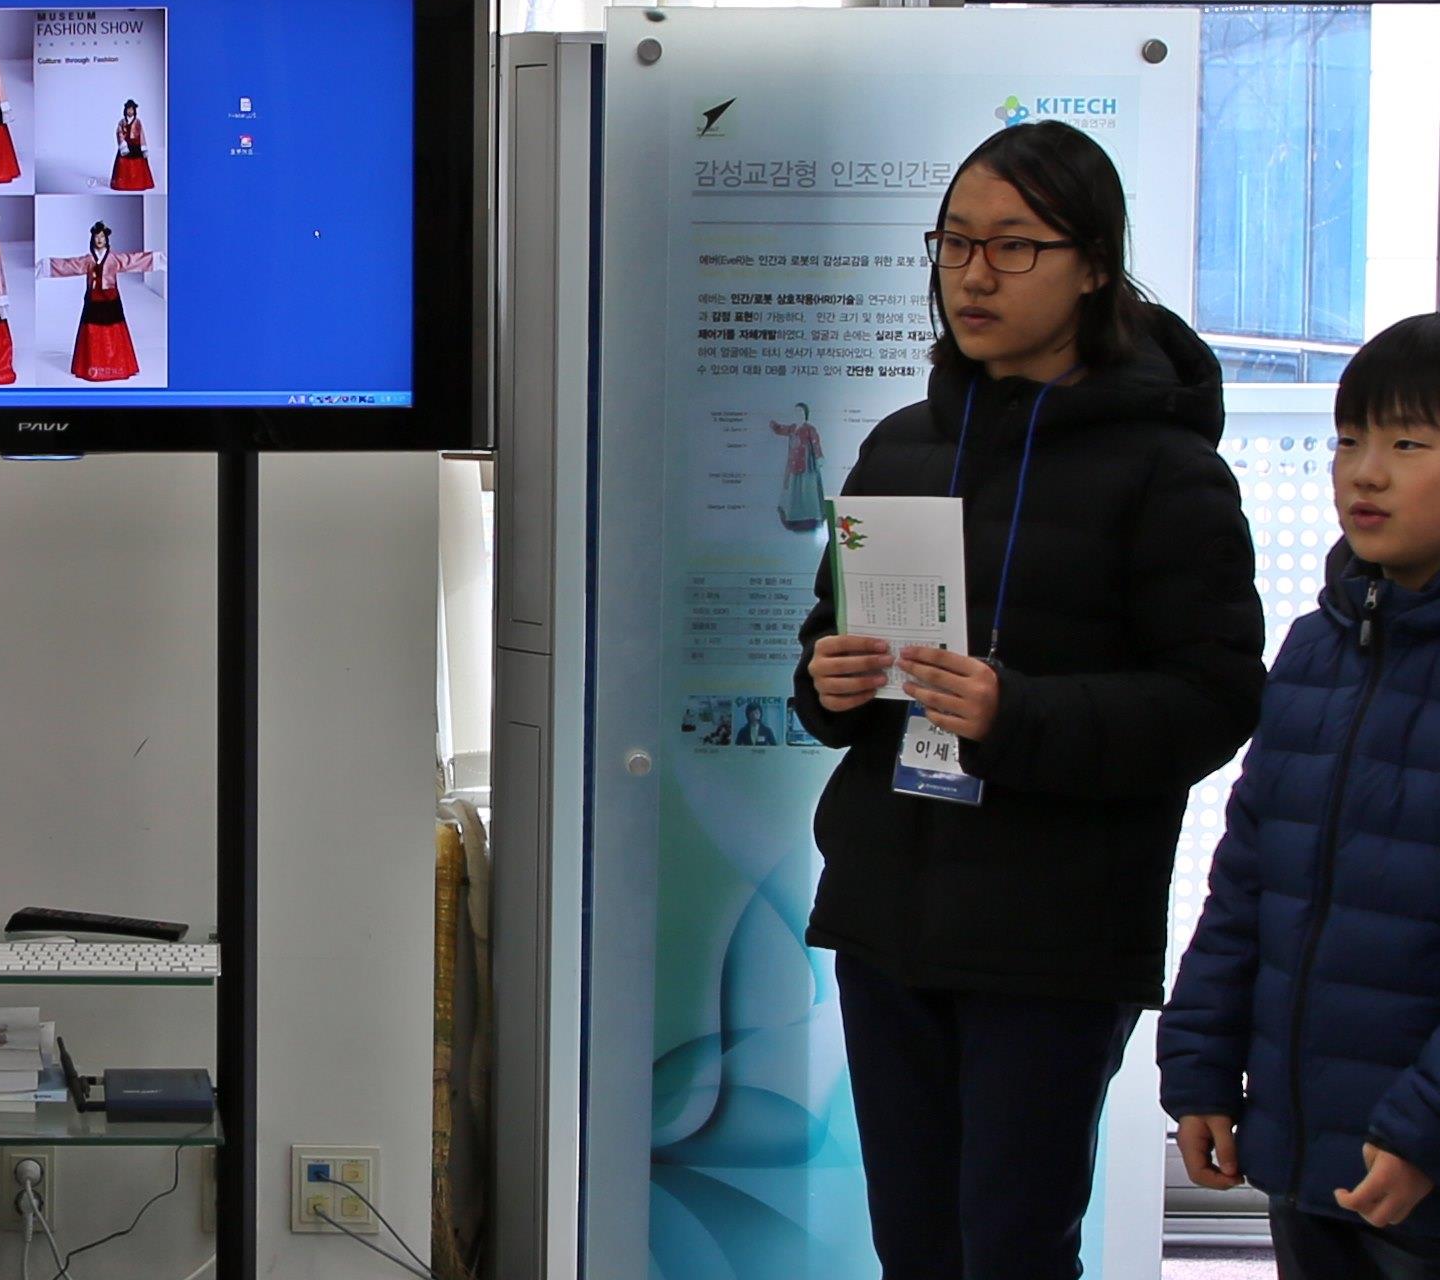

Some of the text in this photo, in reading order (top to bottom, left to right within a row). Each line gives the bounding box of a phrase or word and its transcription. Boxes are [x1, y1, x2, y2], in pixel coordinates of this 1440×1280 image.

[37, 11, 96, 21] MUSEUM
[37, 21, 144, 36] FASHION SHOW
[65, 56, 90, 65] through
[1036, 98, 1116, 114] KITECH
[694, 159, 960, 189] 감성교감형 인조인간로
[758, 255, 787, 267] 인간과
[791, 255, 819, 267] 로봇의
[823, 255, 869, 267] 감성교감을
[874, 255, 893, 267] 위한
[730, 294, 772, 305] 인간/로봇
[868, 294, 906, 305] 연구하기
[816, 311, 835, 323] 인간
[839, 311, 858, 323] 크기
[862, 311, 872, 323] 및
[876, 311, 904, 323] 형상에
[875, 329, 903, 341] 실리콘
[784, 347, 813, 359] 센서가
[742, 365, 762, 377] 대화
[791, 365, 819, 377] 가지고
[823, 365, 842, 377] 있어
[846, 365, 874, 377] 간단한
[915, 740, 959, 762] 이세
